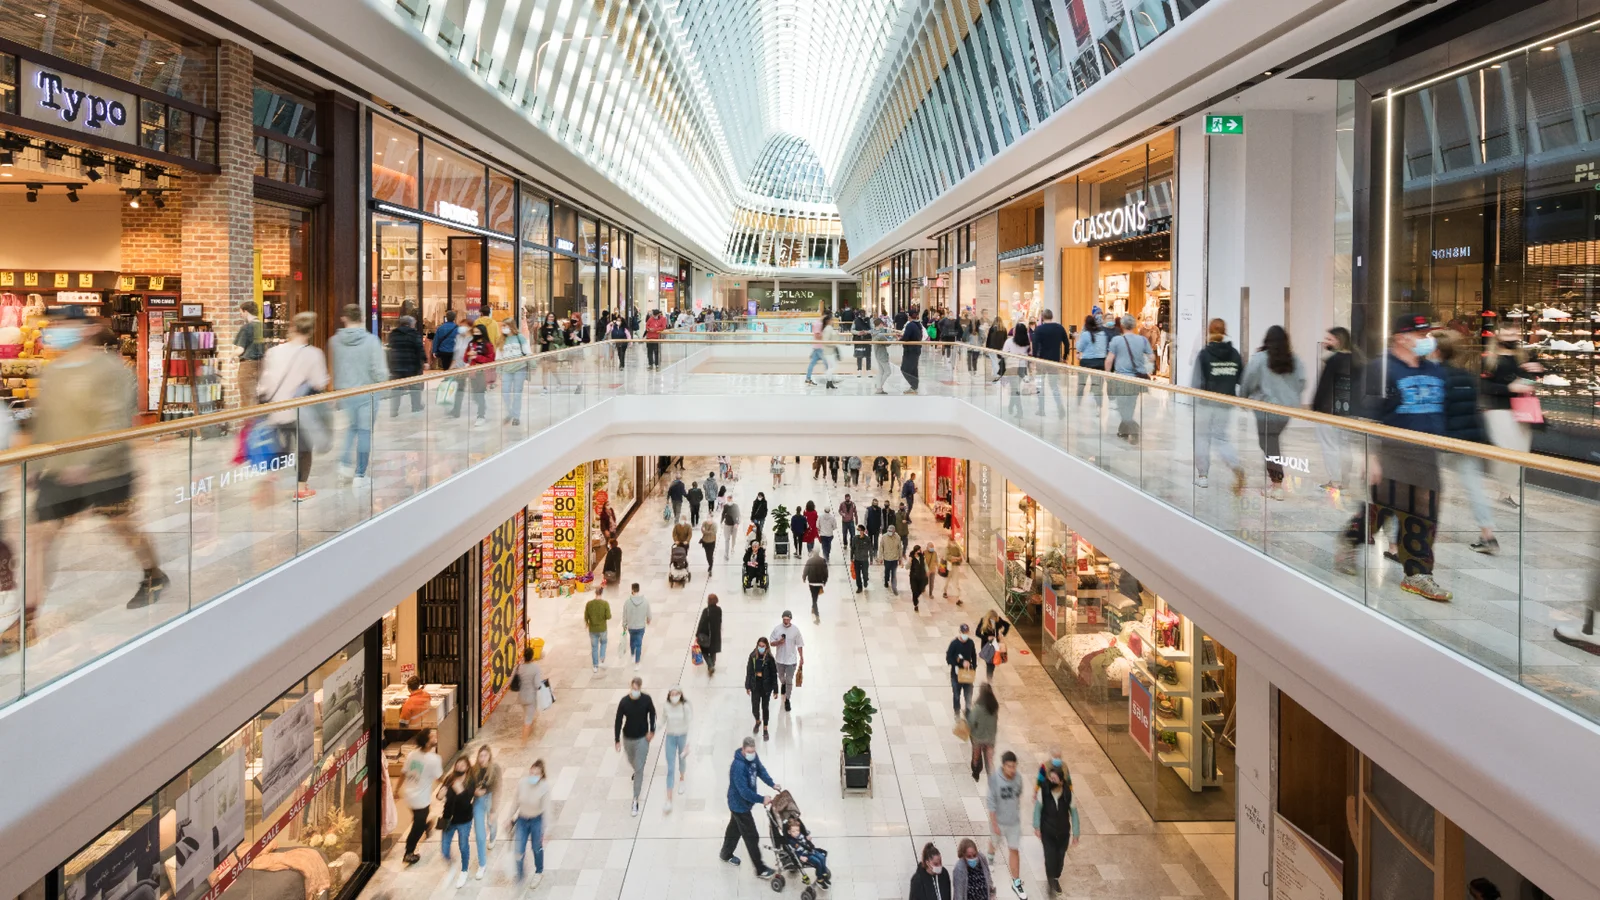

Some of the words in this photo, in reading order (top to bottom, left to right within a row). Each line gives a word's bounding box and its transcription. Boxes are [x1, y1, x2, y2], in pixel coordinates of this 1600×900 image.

[37, 70, 126, 128] Typo
[1072, 200, 1147, 245] GLASSONS
[555, 497, 576, 511] 80
[491, 516, 516, 563] 80
[555, 528, 575, 542] 80
[554, 559, 575, 573] 80
[491, 552, 515, 608] 80
[491, 594, 515, 652] 80
[492, 635, 516, 695] 80
[1132, 702, 1149, 729] sale
[356, 731, 370, 750] SALE
[336, 751, 351, 771] SALE
[313, 773, 330, 794] SALE
[289, 795, 307, 820] SALE
[261, 822, 281, 848] SALE
[216, 858, 231, 875] SALE
[231, 853, 252, 880] SALE
